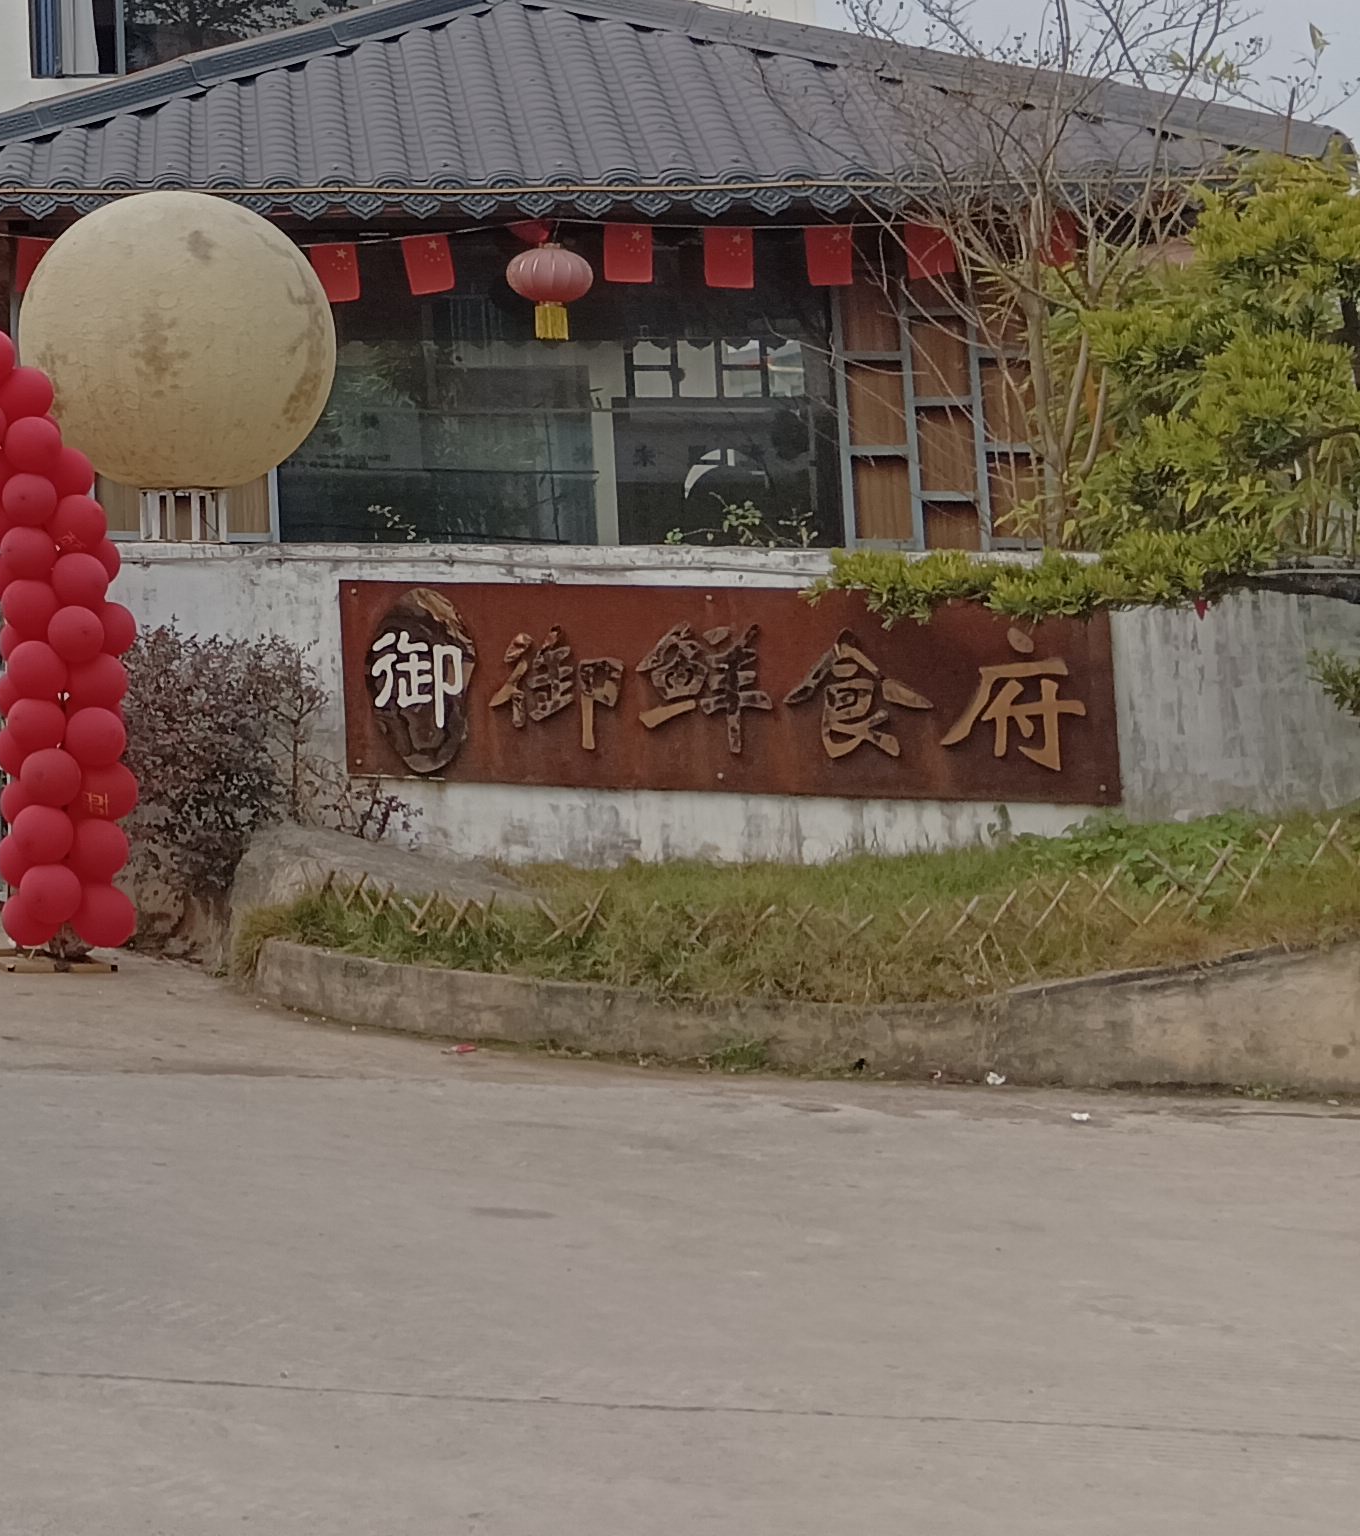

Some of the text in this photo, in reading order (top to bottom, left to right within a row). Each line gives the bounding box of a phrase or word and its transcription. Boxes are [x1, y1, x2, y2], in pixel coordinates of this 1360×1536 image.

[370, 630, 464, 729] 御
[488, 624, 1087, 772] 御鲜食府
